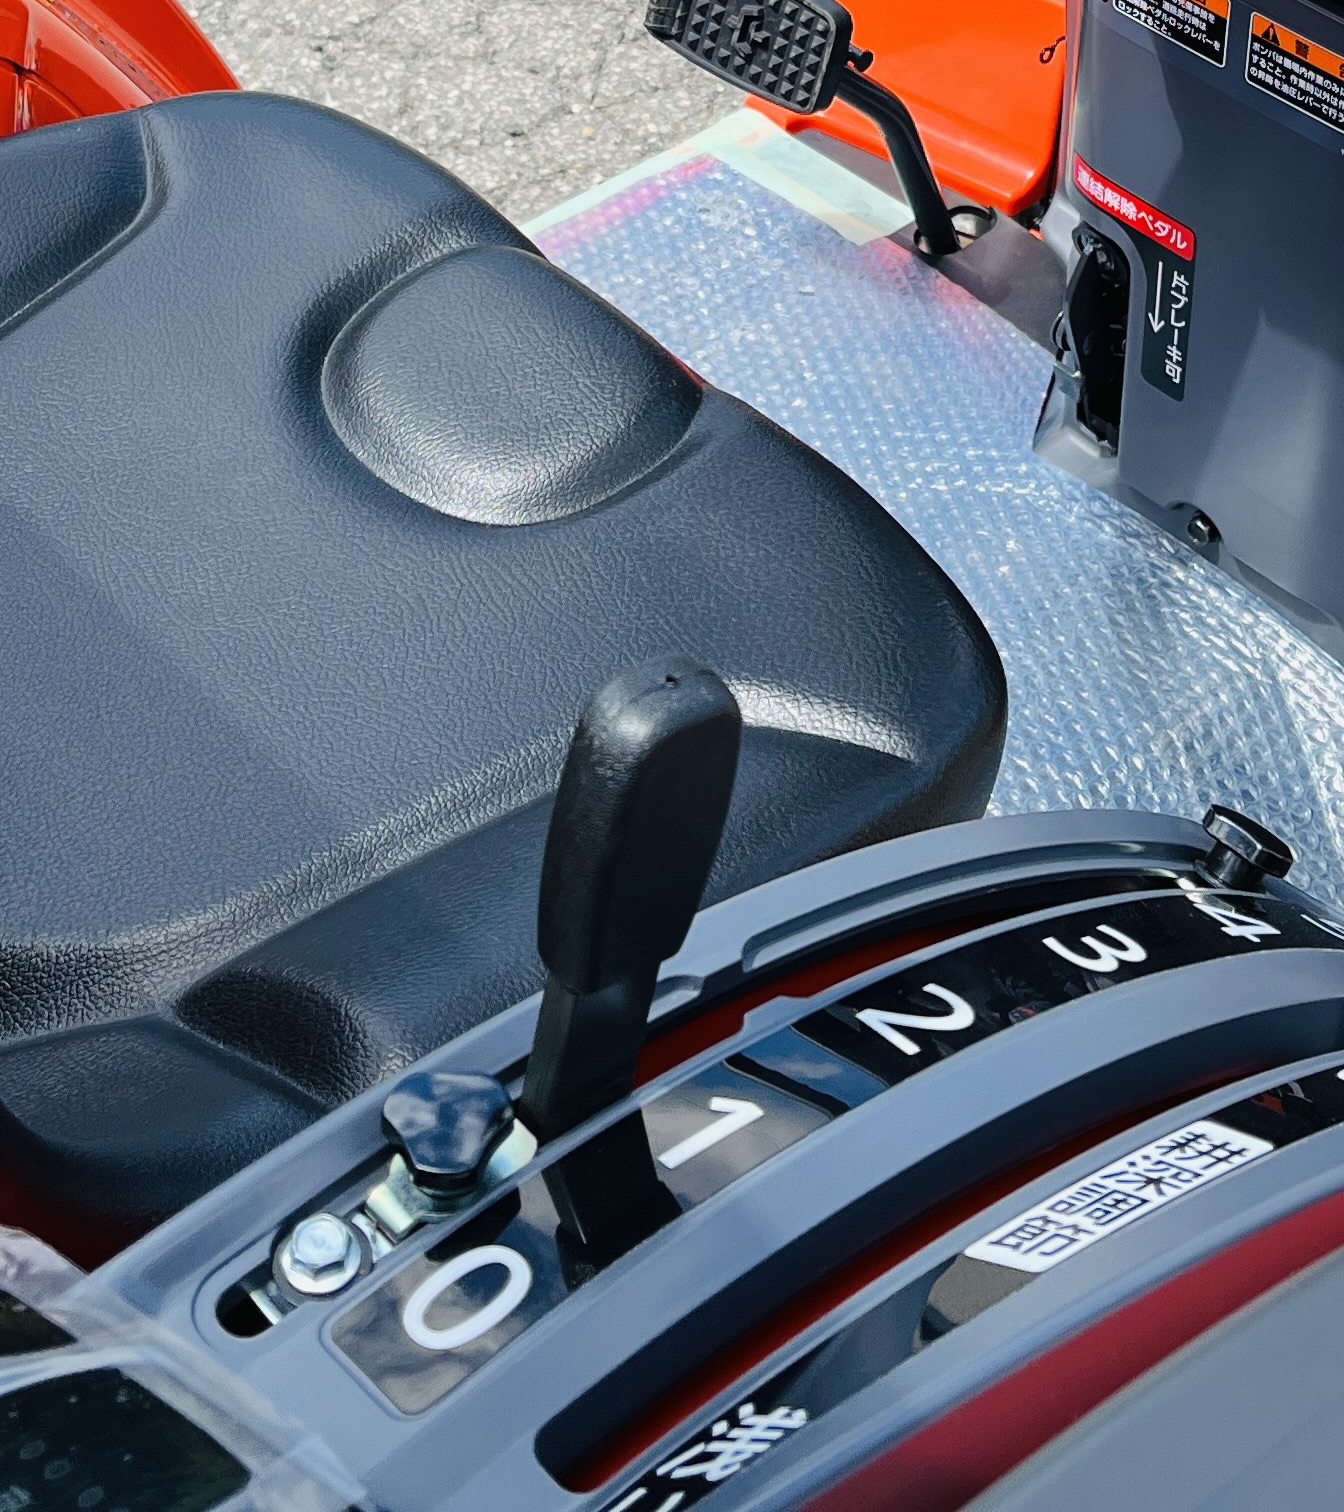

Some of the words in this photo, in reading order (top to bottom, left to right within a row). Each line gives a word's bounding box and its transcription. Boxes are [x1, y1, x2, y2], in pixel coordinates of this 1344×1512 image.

[1077, 165, 1187, 250] 連結解除ペダル
[1164, 270, 1190, 384] 片ブレーキ可
[1042, 923, 1149, 973] 3
[1192, 900, 1282, 944] 4
[856, 982, 976, 1057] 2
[657, 1096, 765, 1170] 1
[987, 1130, 1250, 1258] 耕深調節
[402, 1244, 534, 1351] 0
